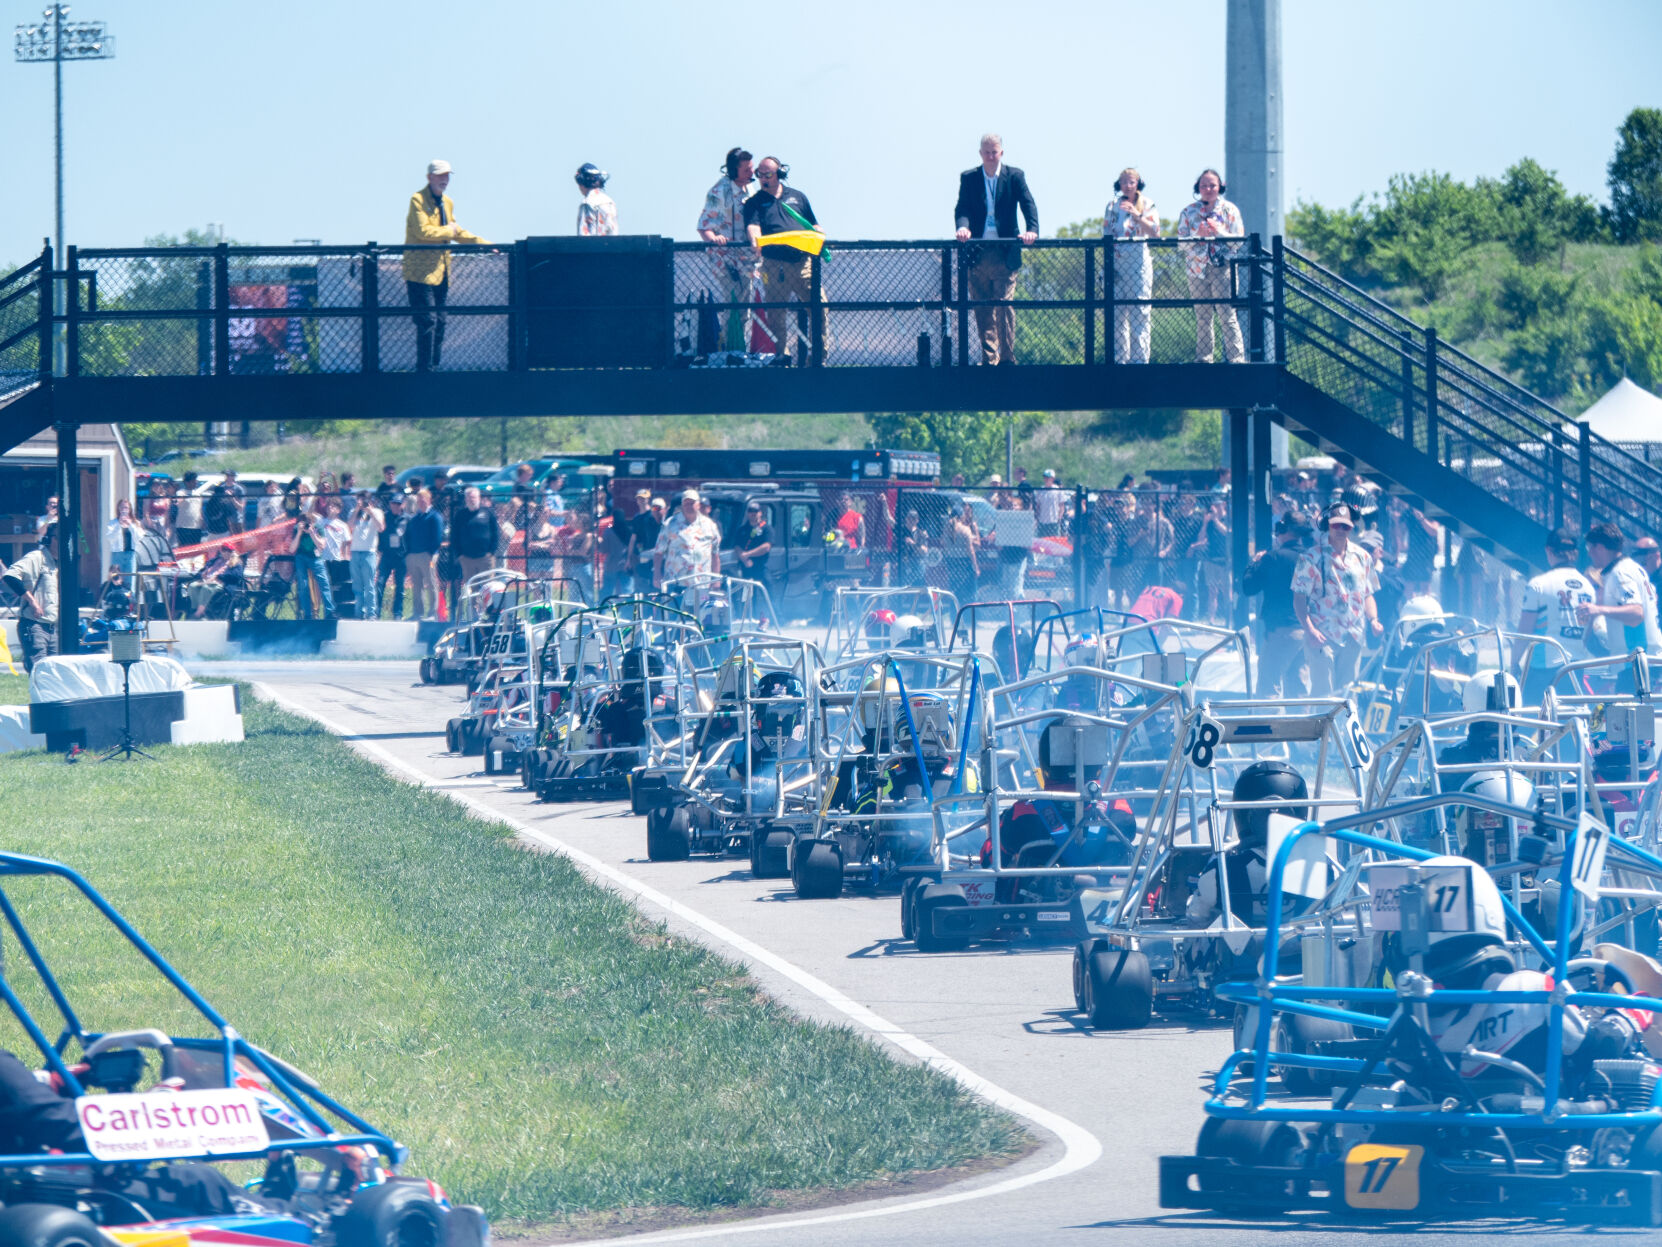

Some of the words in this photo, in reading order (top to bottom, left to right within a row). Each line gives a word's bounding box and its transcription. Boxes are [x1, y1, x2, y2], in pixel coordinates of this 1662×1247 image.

[490, 634, 510, 653] 58
[1434, 886, 1459, 912] 17
[1467, 1009, 1514, 1044] ART
[83, 1101, 252, 1132] Carlstrom
[1358, 1156, 1403, 1194] 17
